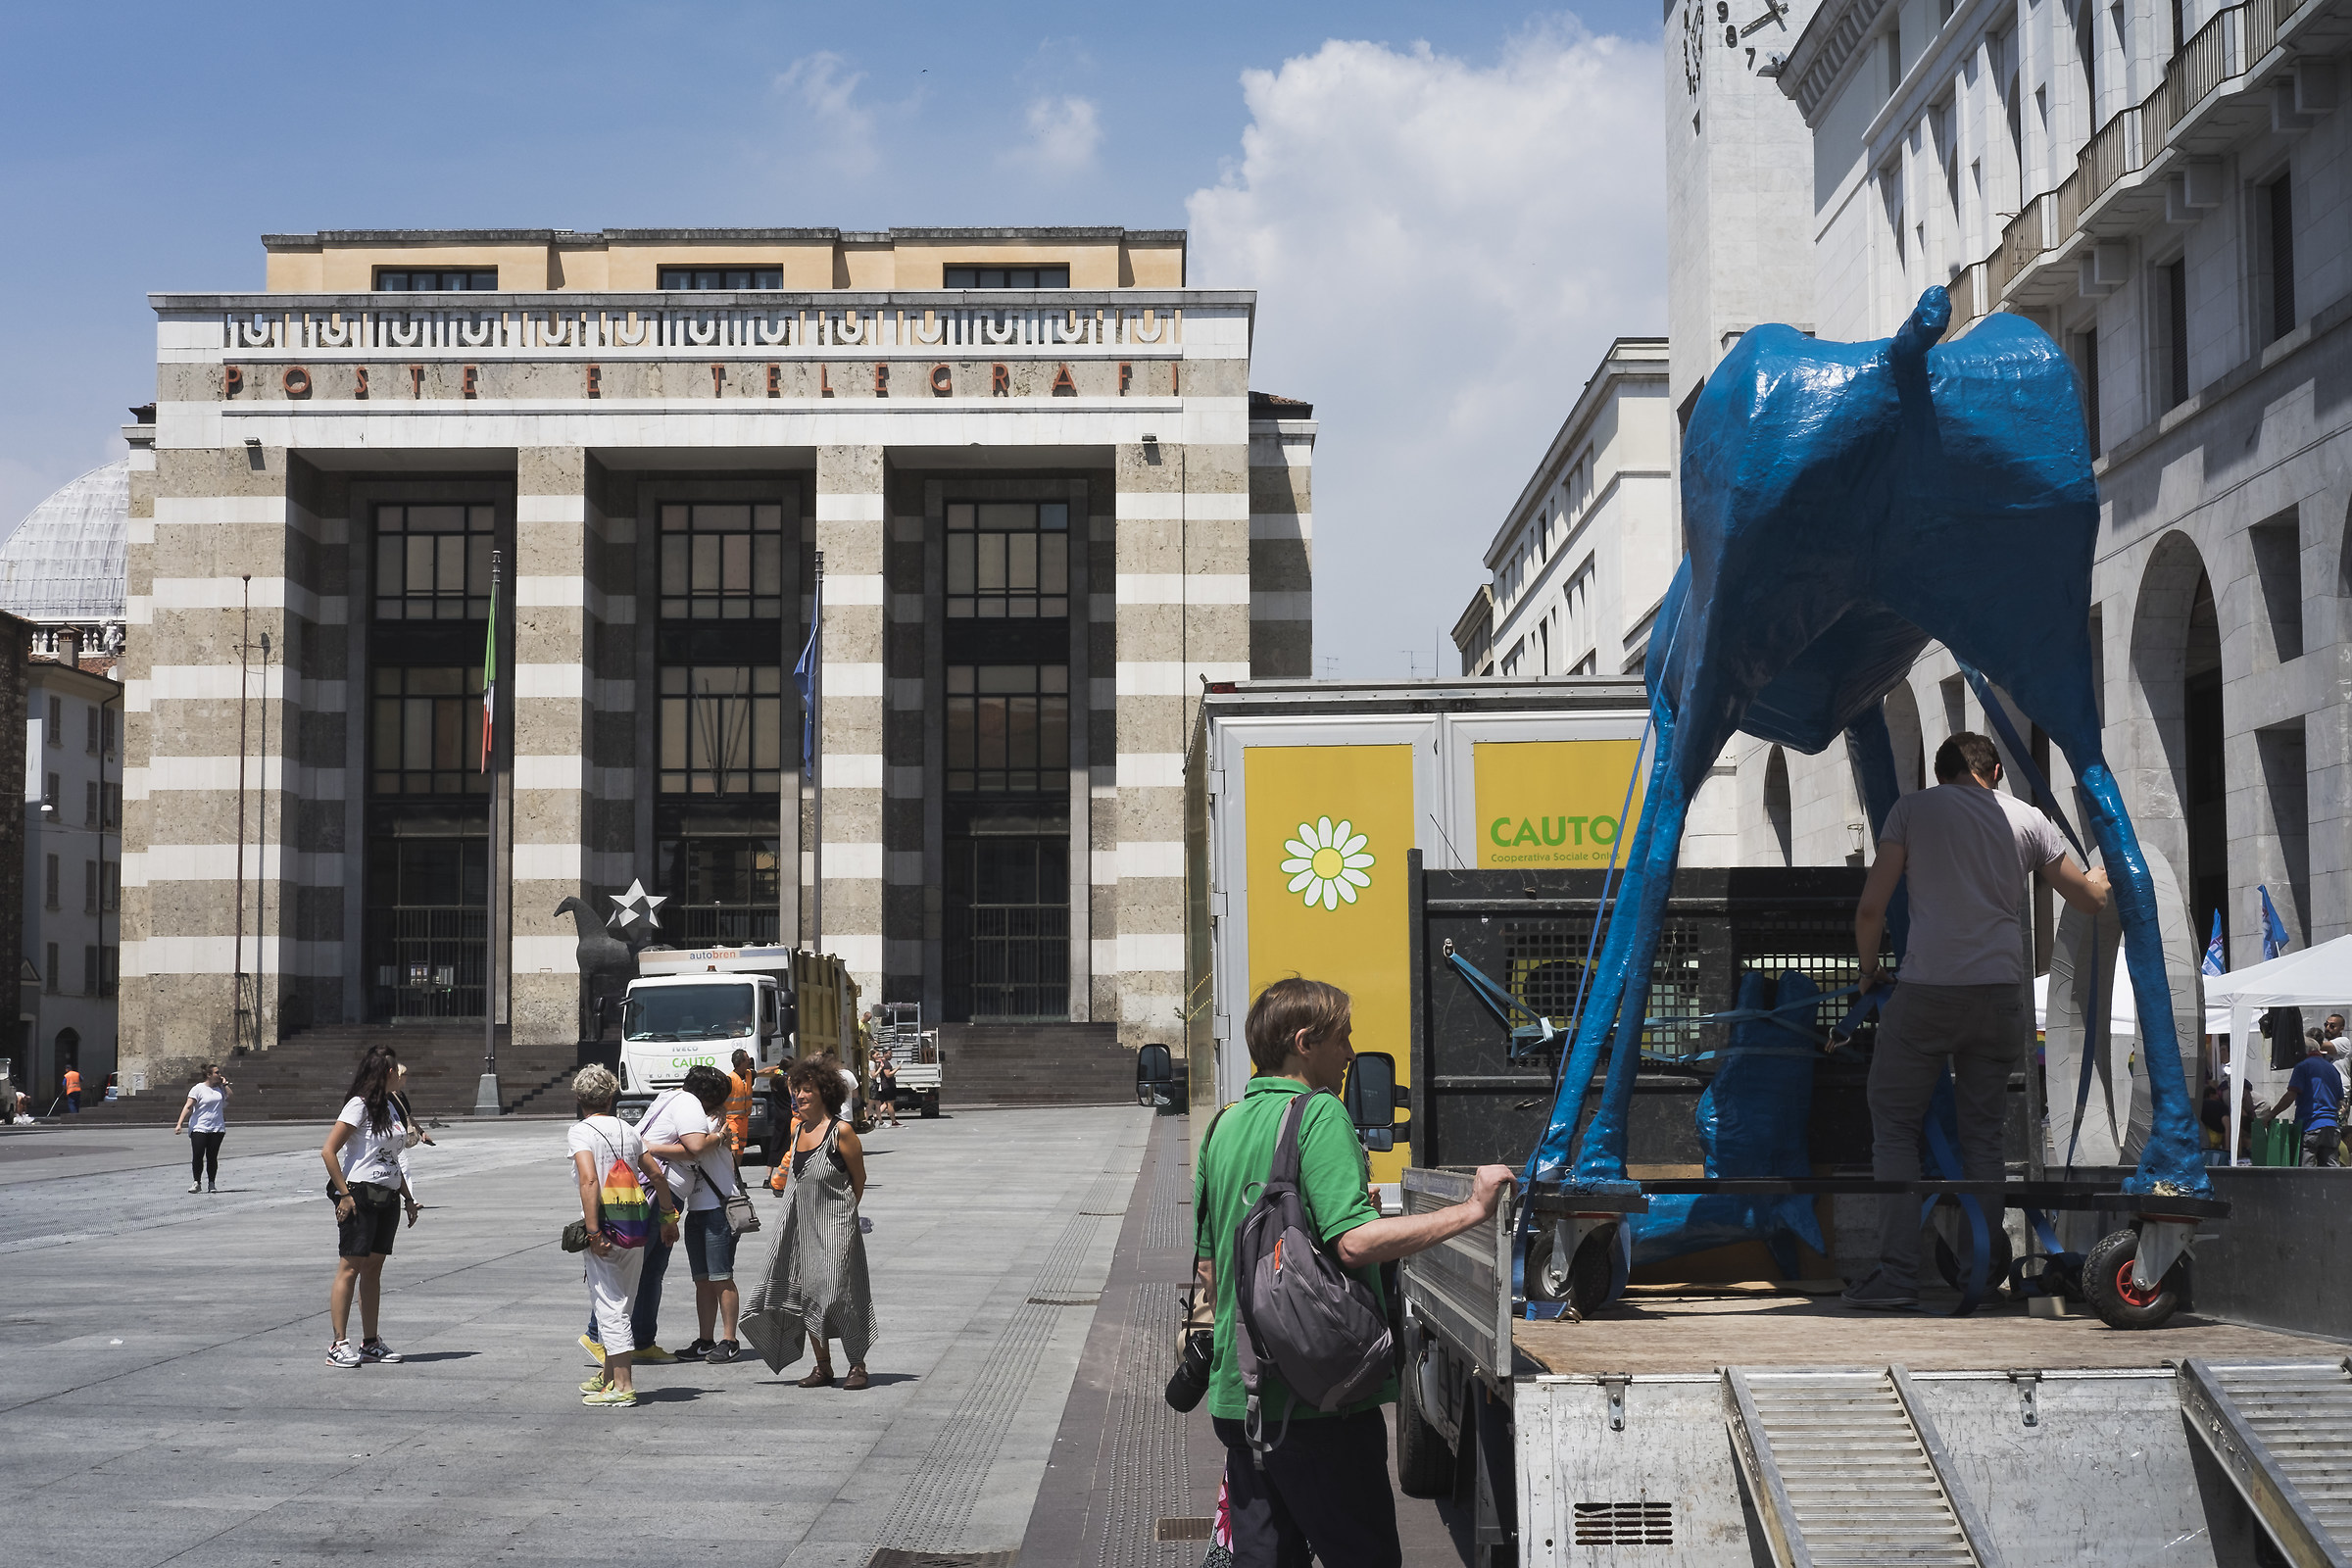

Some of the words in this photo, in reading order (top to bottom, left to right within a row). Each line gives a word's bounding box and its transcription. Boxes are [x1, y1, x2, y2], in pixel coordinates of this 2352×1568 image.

[1726, 25, 1737, 47] 8
[1745, 48, 1756, 71] 7
[224, 365, 477, 395] POSTE
[587, 364, 601, 394] E
[710, 363, 1179, 394] TELEGRAFI
[1490, 815, 1620, 847] CAUTO
[1491, 854, 1550, 863] Cooperativa
[1553, 853, 1589, 861] Sociale
[689, 951, 736, 960] autobren
[672, 1056, 715, 1068] CAUTO
[1345, 1362, 1370, 1388] Quechua
